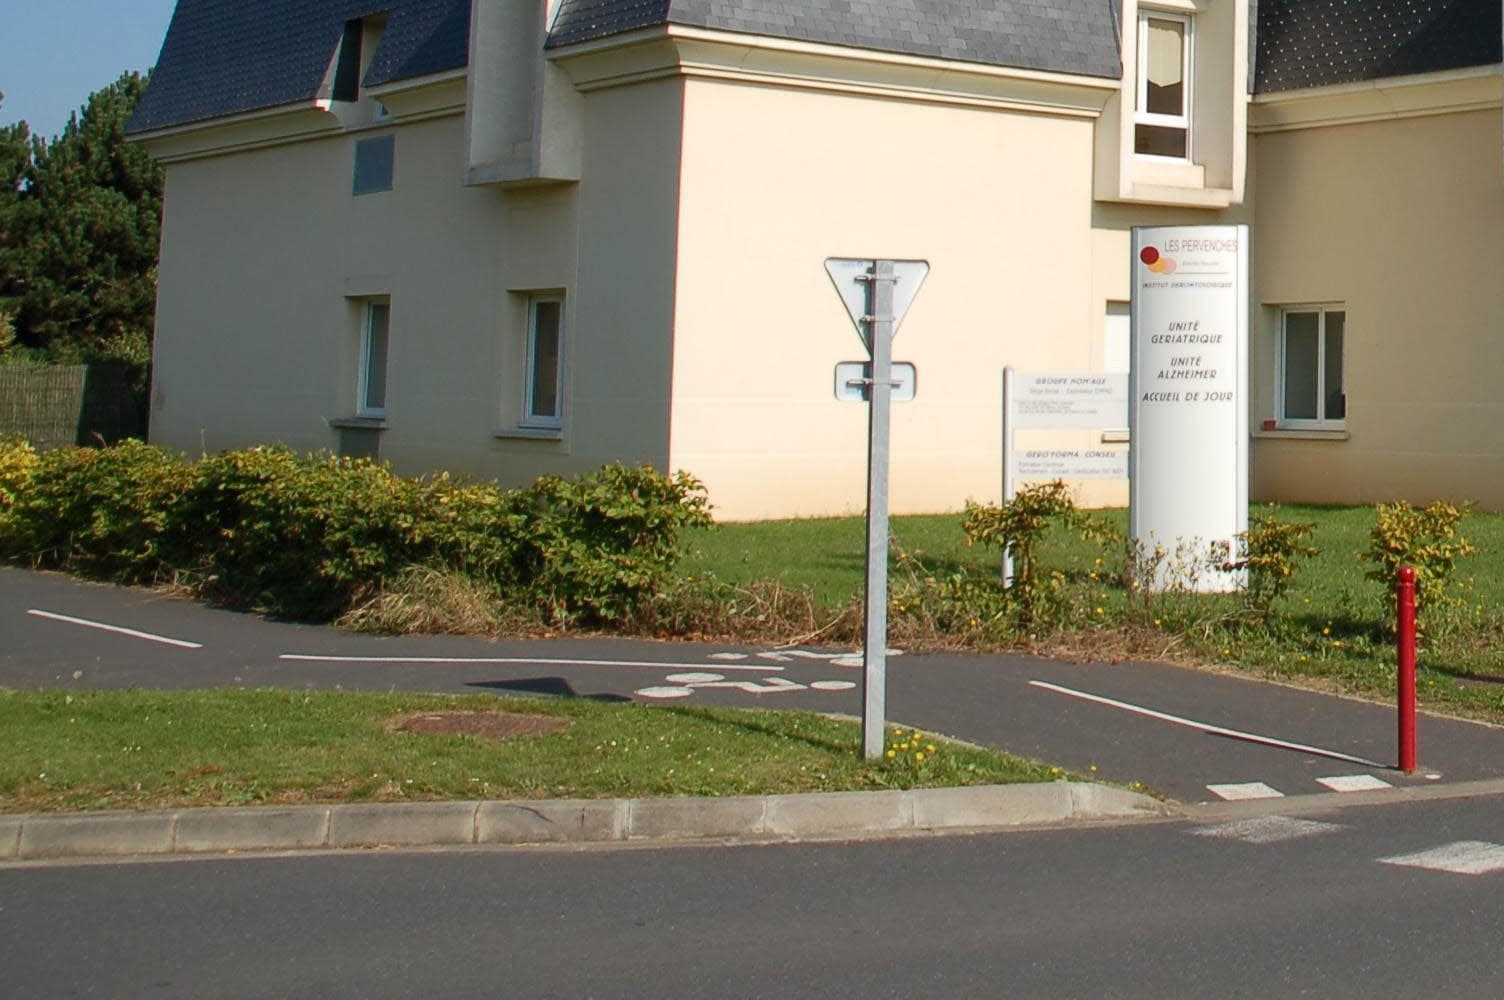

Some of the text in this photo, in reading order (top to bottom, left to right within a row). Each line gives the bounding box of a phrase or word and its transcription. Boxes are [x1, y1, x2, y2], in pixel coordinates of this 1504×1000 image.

[1164, 239, 1239, 253] LES PERVENCHES
[1151, 334, 1223, 344] GERIATRIQUE
[1157, 369, 1217, 379] ALZHEIMER
[1142, 391, 1234, 401] ACCUEIL DE JOUR
